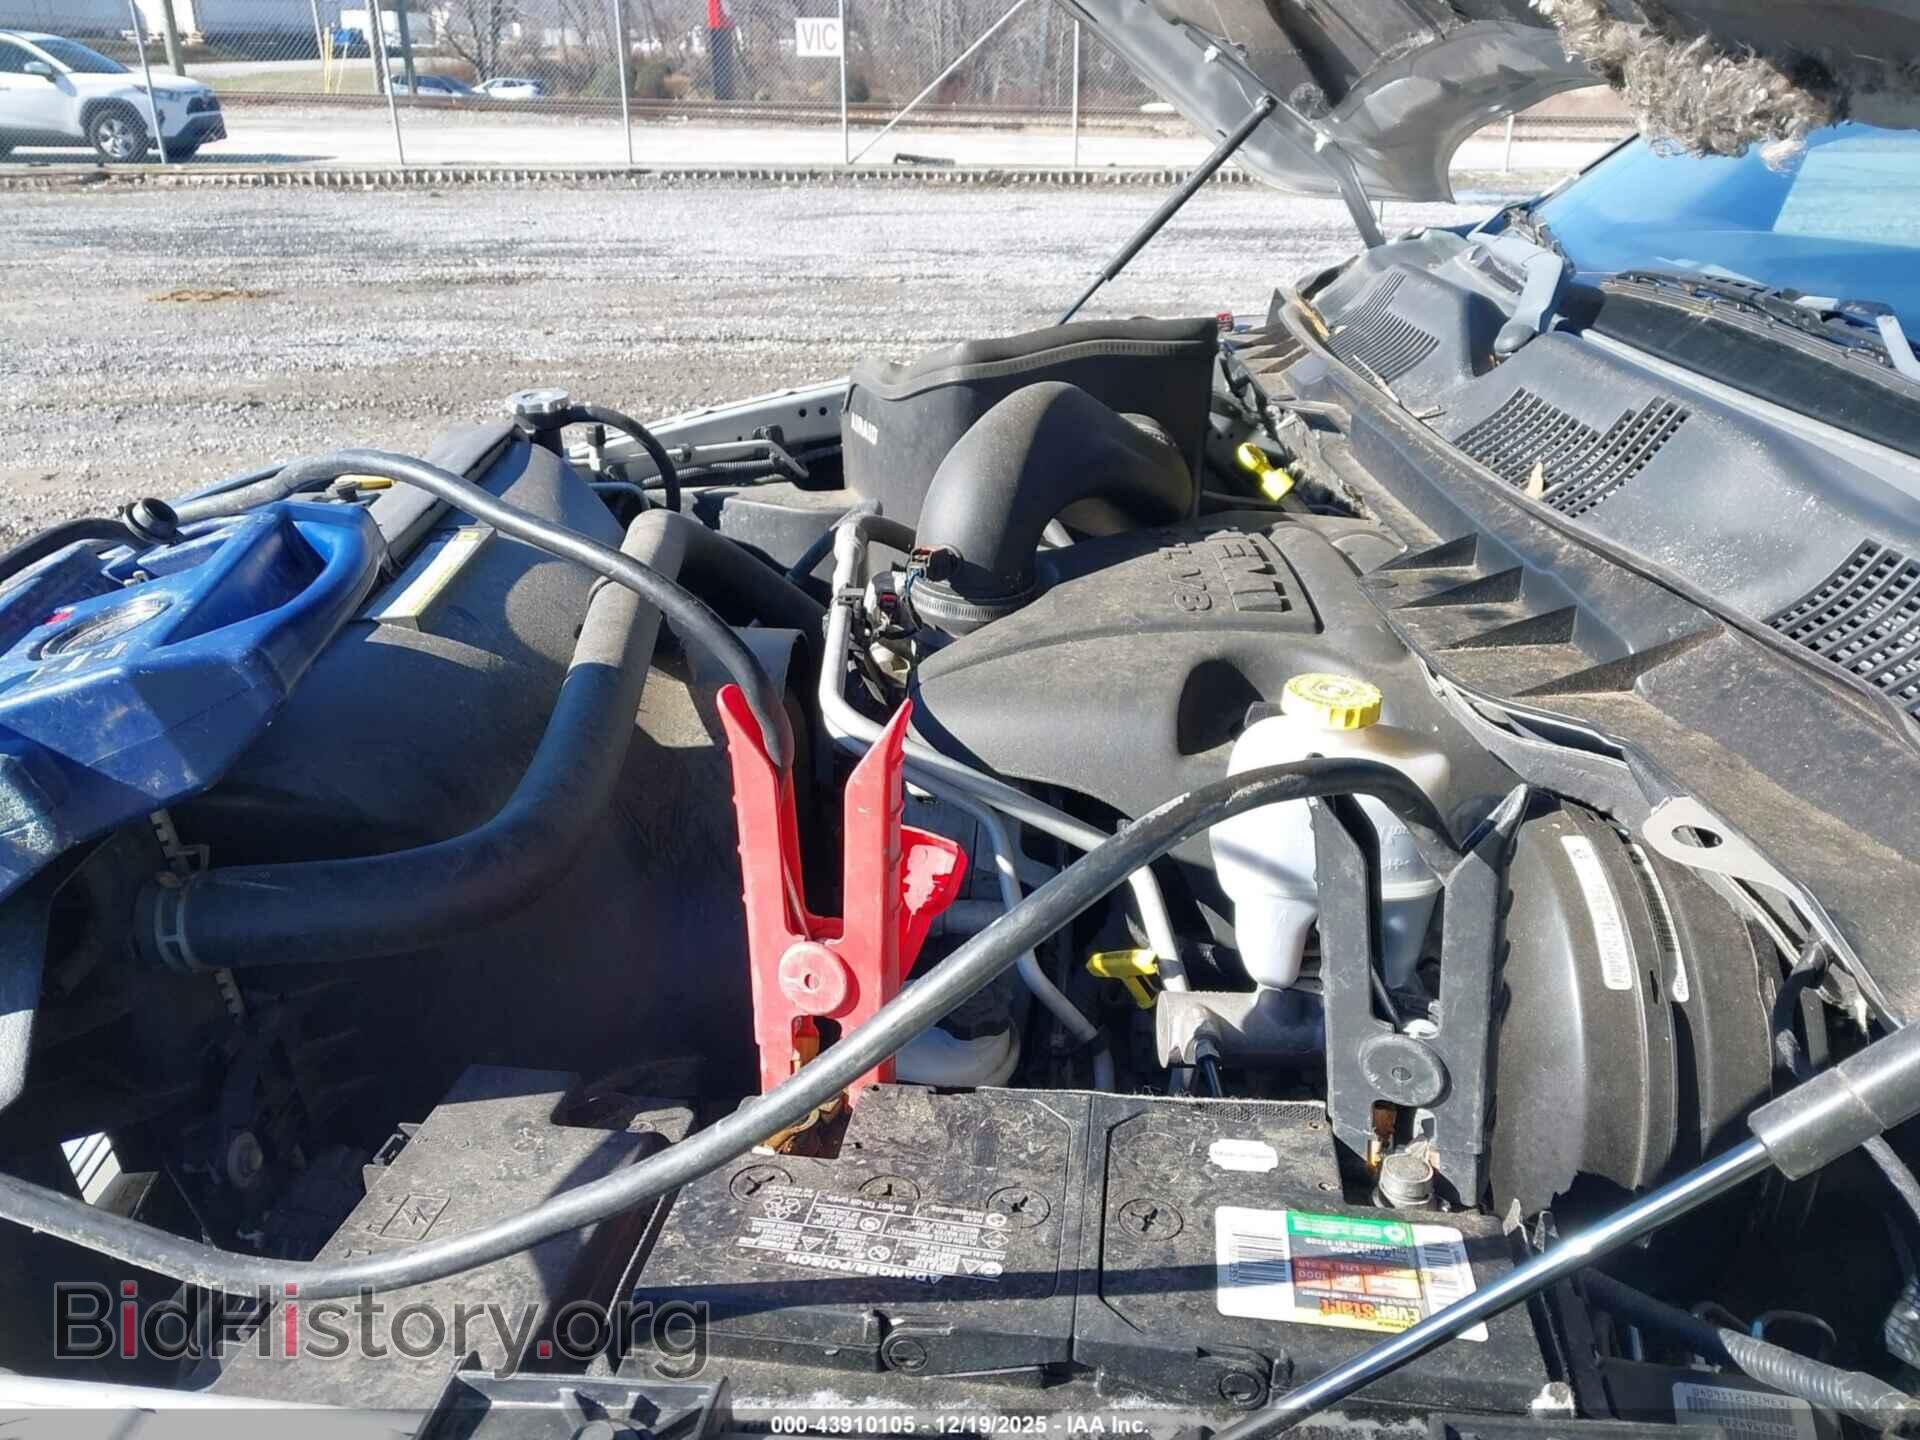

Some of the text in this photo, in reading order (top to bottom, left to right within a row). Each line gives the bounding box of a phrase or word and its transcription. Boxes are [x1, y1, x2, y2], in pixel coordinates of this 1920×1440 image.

[801, 23, 837, 50] VIC
[786, 1253, 928, 1281] DANGER/POISON
[1297, 1269, 1329, 1280] 1000
[1319, 1298, 1421, 1323] EverStart
